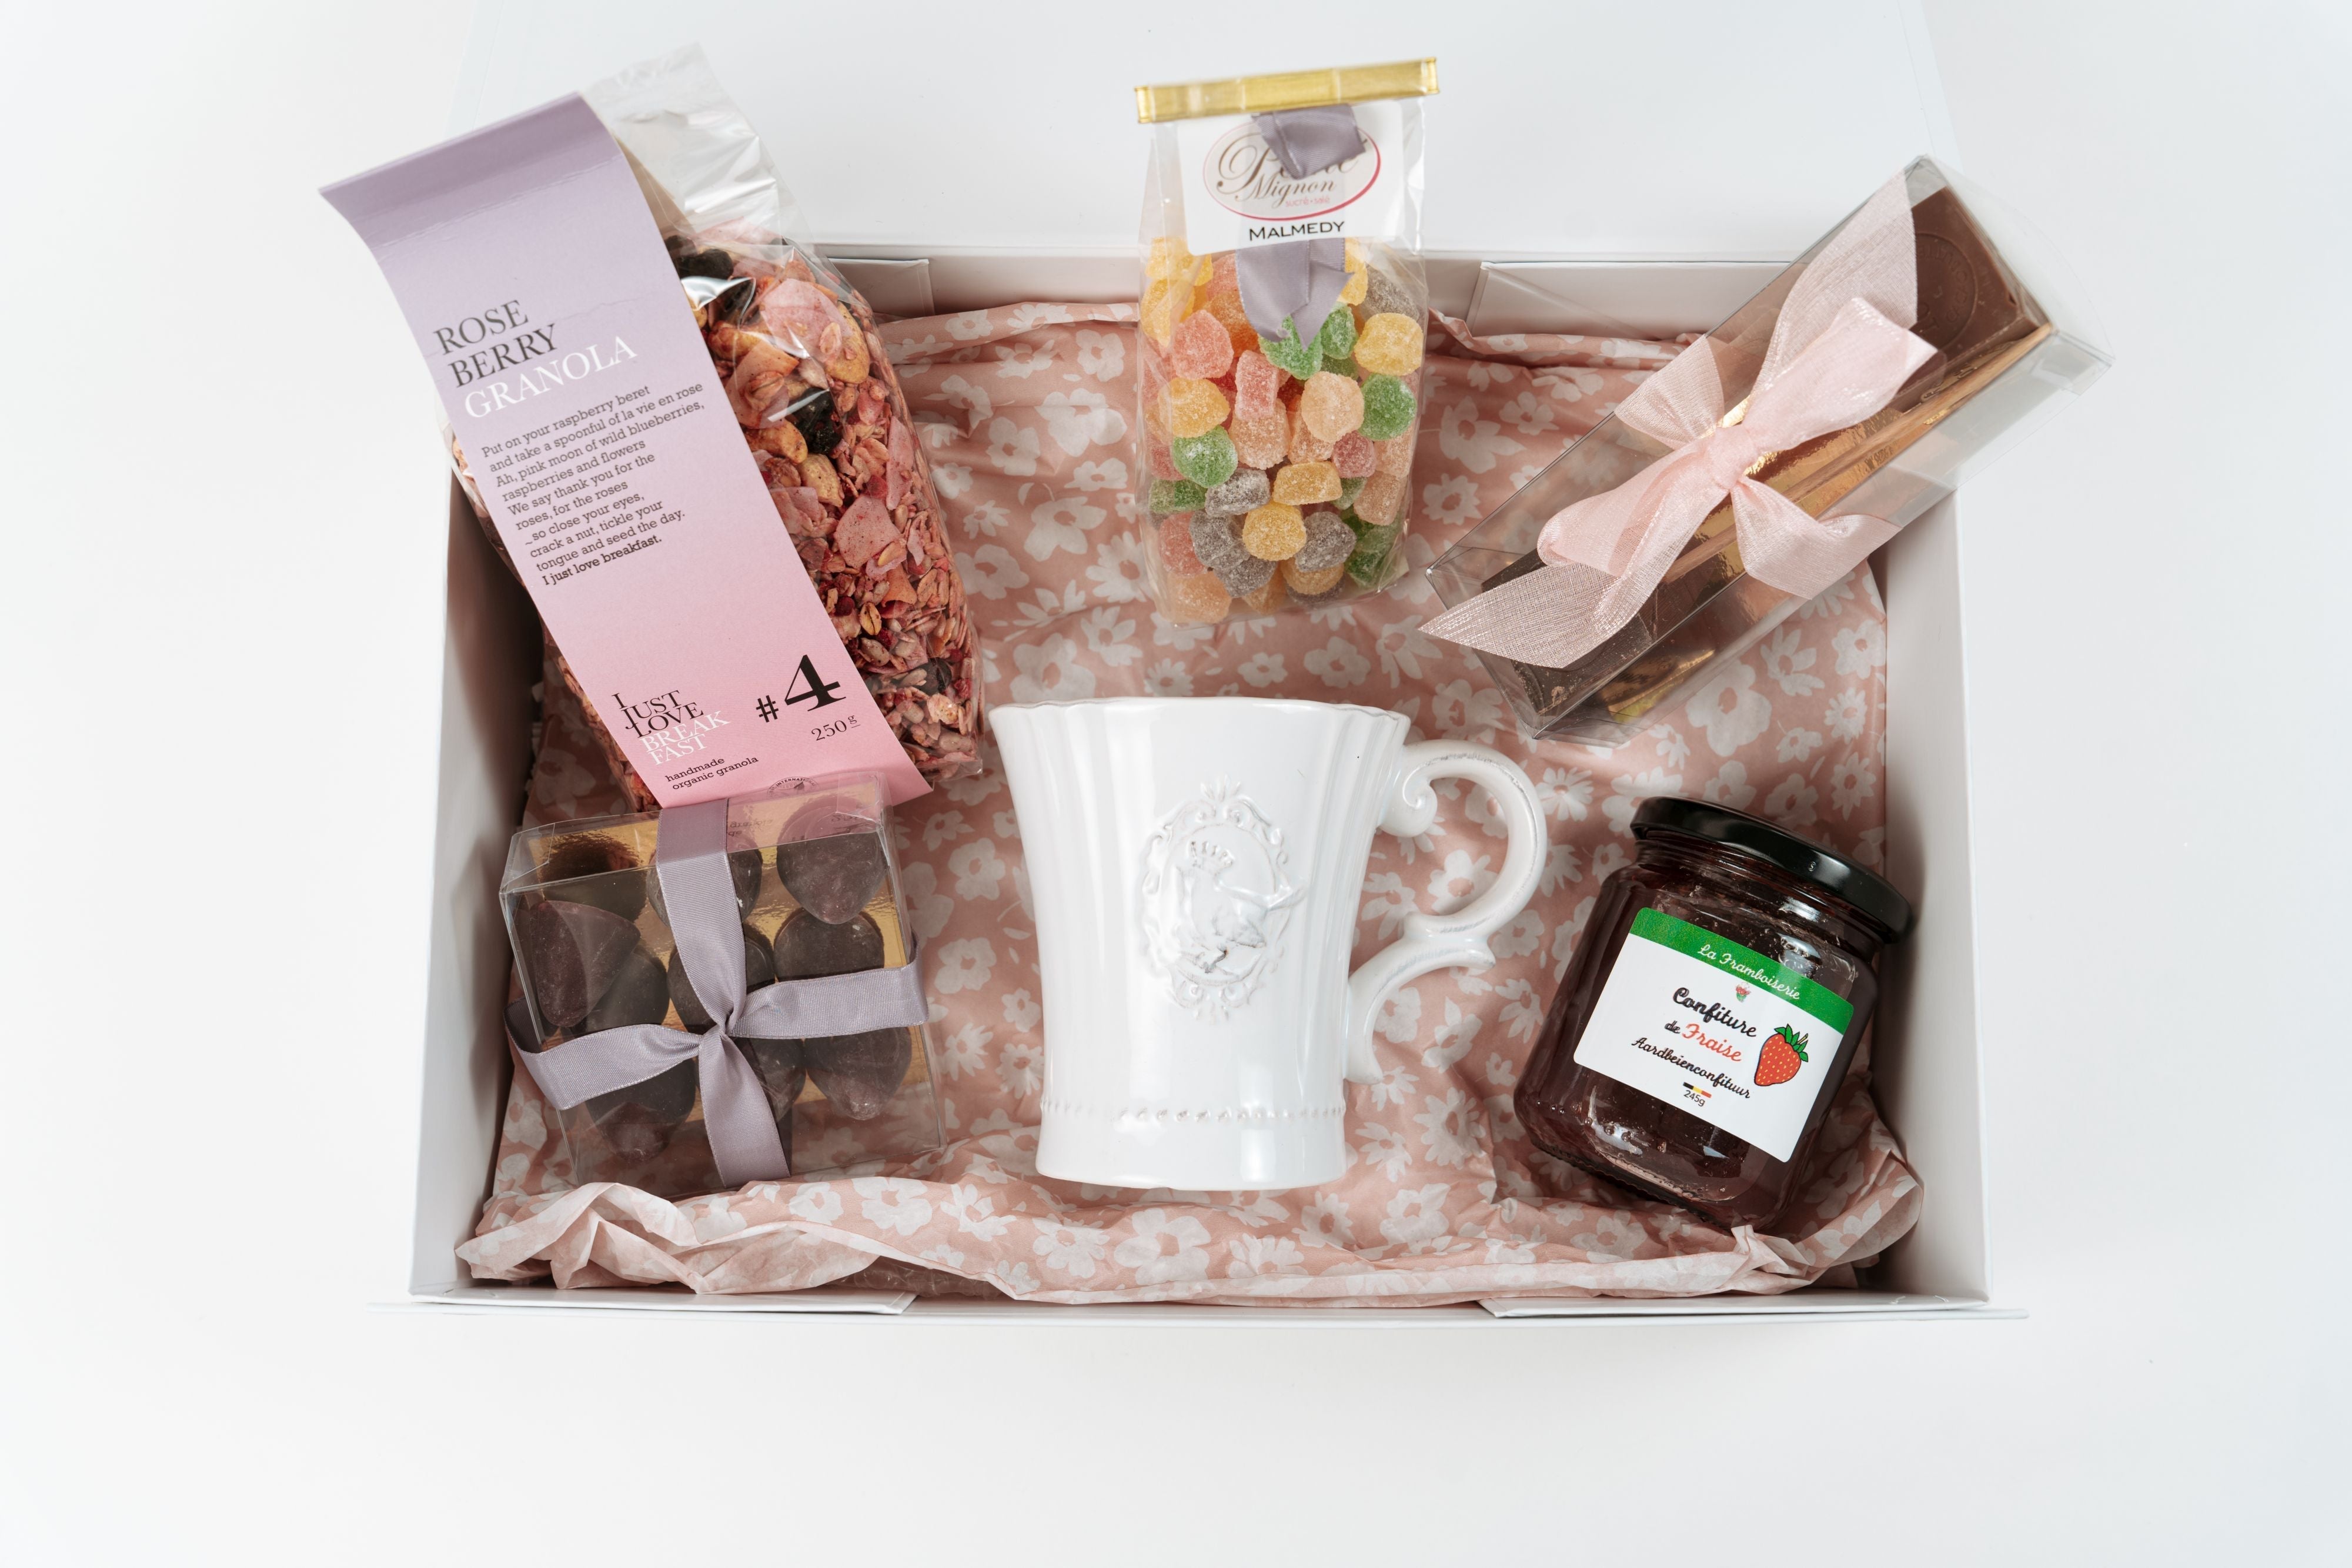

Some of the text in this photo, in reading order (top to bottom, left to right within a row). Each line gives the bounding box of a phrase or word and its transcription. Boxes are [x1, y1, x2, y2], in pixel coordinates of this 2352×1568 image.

[1235, 172, 1335, 209] Mignon
[1250, 220, 1345, 241] MALMEDY
[433, 300, 529, 356] ROSE
[447, 323, 557, 388] BERRY
[465, 335, 638, 418] GRANOLA
[481, 386, 650, 457] Put on your raspberry beret
[490, 455, 513, 472] and
[514, 447, 541, 462] take
[553, 419, 606, 447] spoonful
[608, 412, 621, 425] of
[621, 410, 634, 420] la
[636, 402, 655, 414] vie
[658, 395, 674, 406] en
[676, 384, 702, 399] rose
[496, 402, 704, 487] Ah, pink moon of wild blueberries,
[502, 440, 645, 502] raspberries and flowers
[507, 454, 654, 515] We say thank you for the
[515, 482, 627, 530] roses, for the roses
[530, 539, 564, 557] crack
[575, 526, 599, 540] nut,
[599, 513, 633, 530] tickle
[634, 501, 663, 520] your
[549, 517, 580, 534] close
[582, 505, 610, 523] your
[613, 493, 644, 509] eyes,
[536, 510, 684, 571] tongue and seed the day.
[542, 534, 662, 585] I just love breakfast.
[612, 693, 628, 709] I
[621, 690, 681, 730] JUST
[633, 702, 704, 738] LOVE
[639, 711, 731, 753] BREAK
[648, 734, 707, 765] FAST
[665, 758, 725, 782] handmade
[673, 756, 759, 790] organic granola
[1698, 944, 1800, 999] La Framboiserie
[1673, 987, 1757, 1037] Confiture
[1665, 1020, 1742, 1062] de Fraise
[1631, 1037, 1750, 1099] Aardbeienconfituur
[1683, 1090, 1706, 1106] 245g
